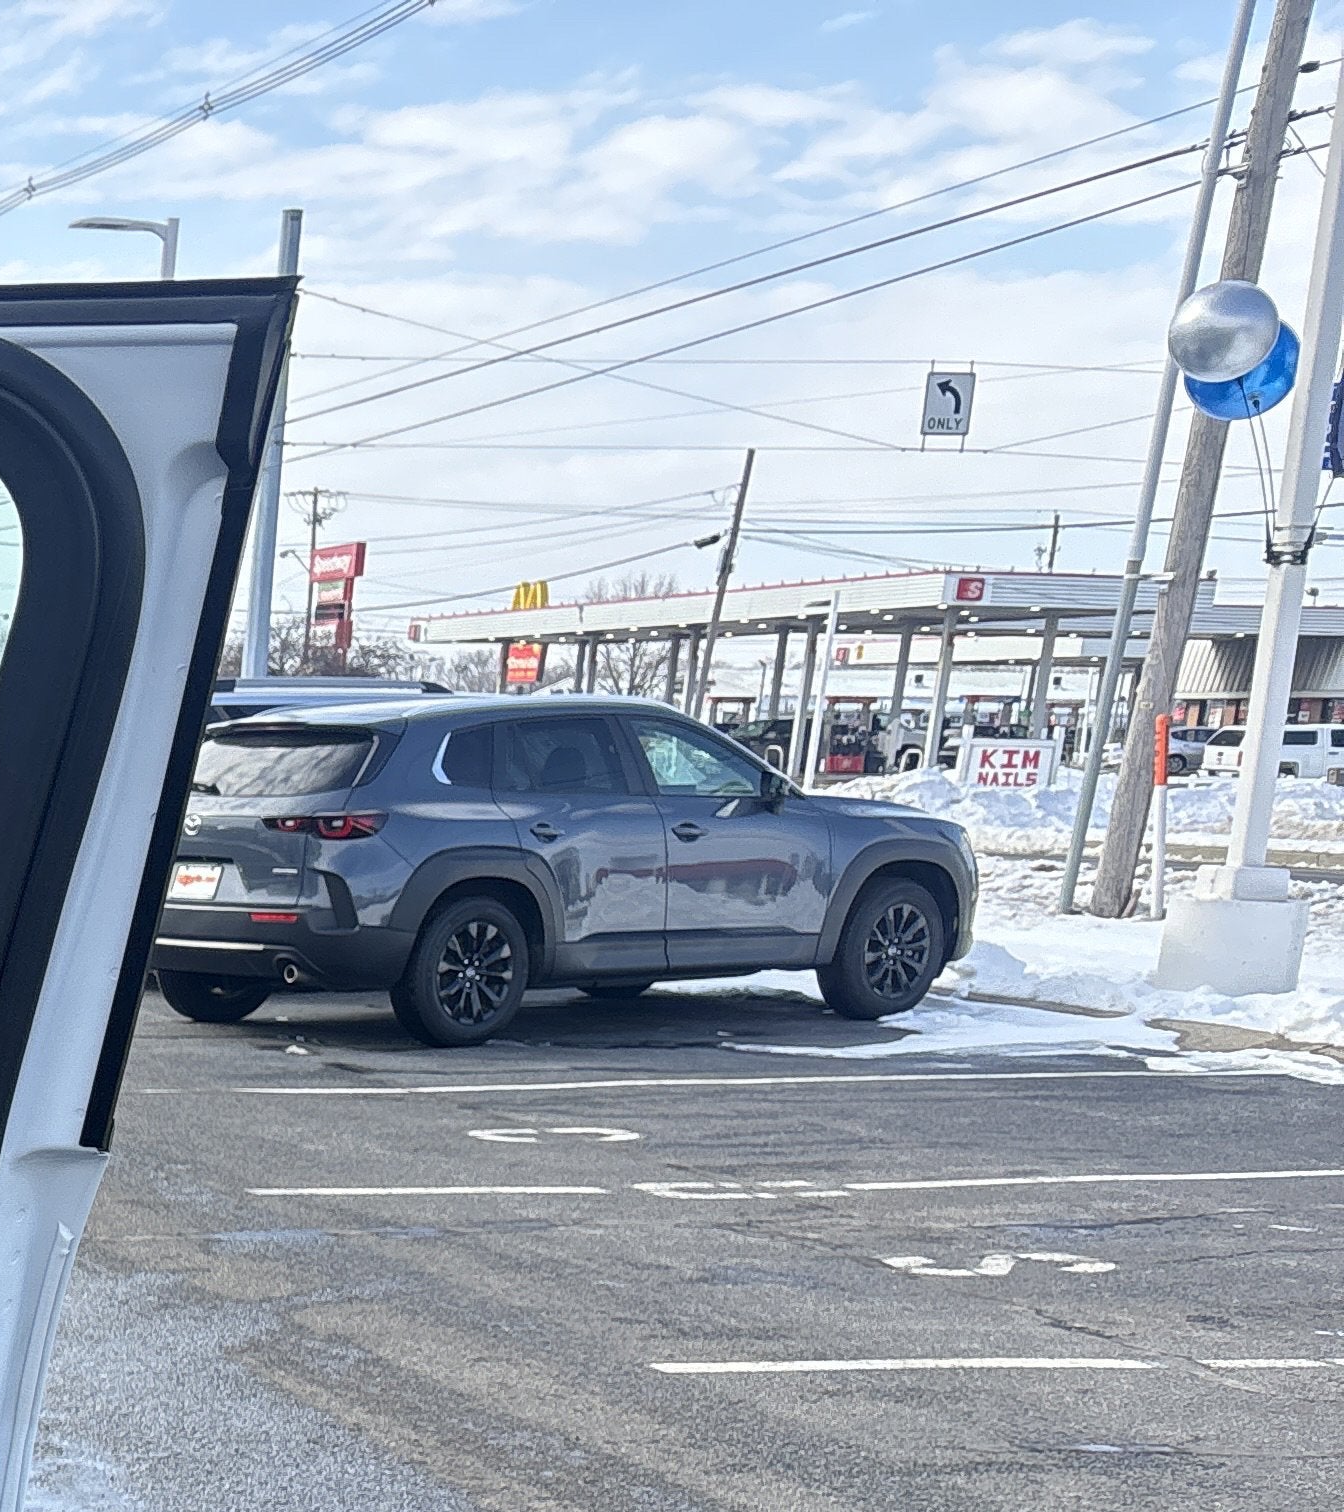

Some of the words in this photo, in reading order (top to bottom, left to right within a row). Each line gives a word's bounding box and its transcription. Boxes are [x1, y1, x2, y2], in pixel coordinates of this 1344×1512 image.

[927, 417, 963, 430] ONLY
[979, 749, 1041, 769] KIM
[977, 772, 1038, 787] NAILS
